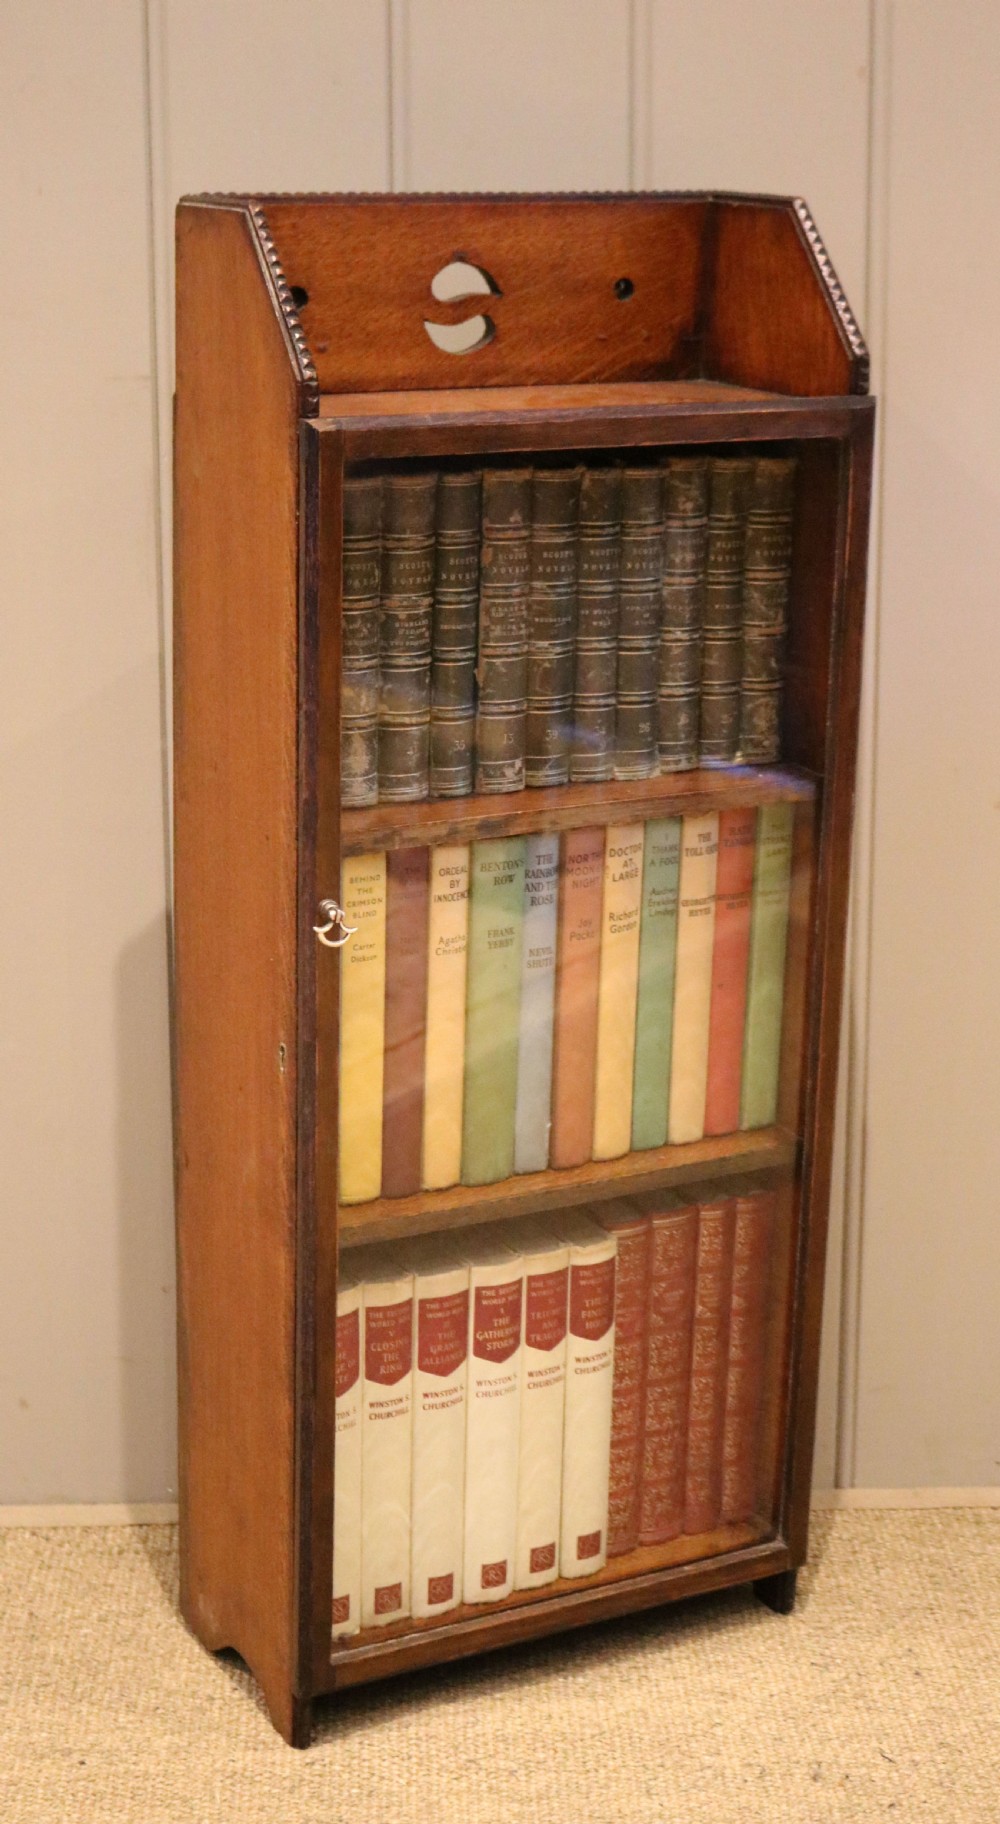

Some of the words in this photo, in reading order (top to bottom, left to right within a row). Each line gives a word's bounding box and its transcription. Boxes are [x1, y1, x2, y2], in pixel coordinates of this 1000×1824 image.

[608, 843, 642, 858] DOCTOR
[536, 854, 553, 865] THE
[623, 858, 634, 869] AT
[438, 865, 468, 877] ORDEAL
[612, 868, 640, 882] LARGE
[350, 874, 381, 884] BEHIND
[449, 879, 462, 889] BY
[494, 874, 515, 886] ROW
[357, 887, 373, 895] THE
[524, 881, 544, 893] AND
[346, 898, 383, 908] CRIMSON
[530, 895, 554, 907] ROSE
[352, 910, 377, 919] BLIND
[608, 907, 638, 922] Richard
[487, 927, 515, 939] FRANK
[488, 939, 514, 950] YERBY
[481, 1289, 496, 1297] THE
[492, 1316, 511, 1327] THE
[438, 1330, 456, 1340] THE
[370, 1337, 409, 1352] CLOSING
[485, 1338, 515, 1351] STORM
[382, 1352, 400, 1363] THE
[379, 1364, 403, 1375] RING
[527, 1365, 560, 1378] WINSTON
[476, 1376, 512, 1388] WINSTON
[422, 1387, 458, 1399] WINSTON
[368, 1396, 403, 1409] WINSTON
[422, 1396, 464, 1411] CHURCHILL
